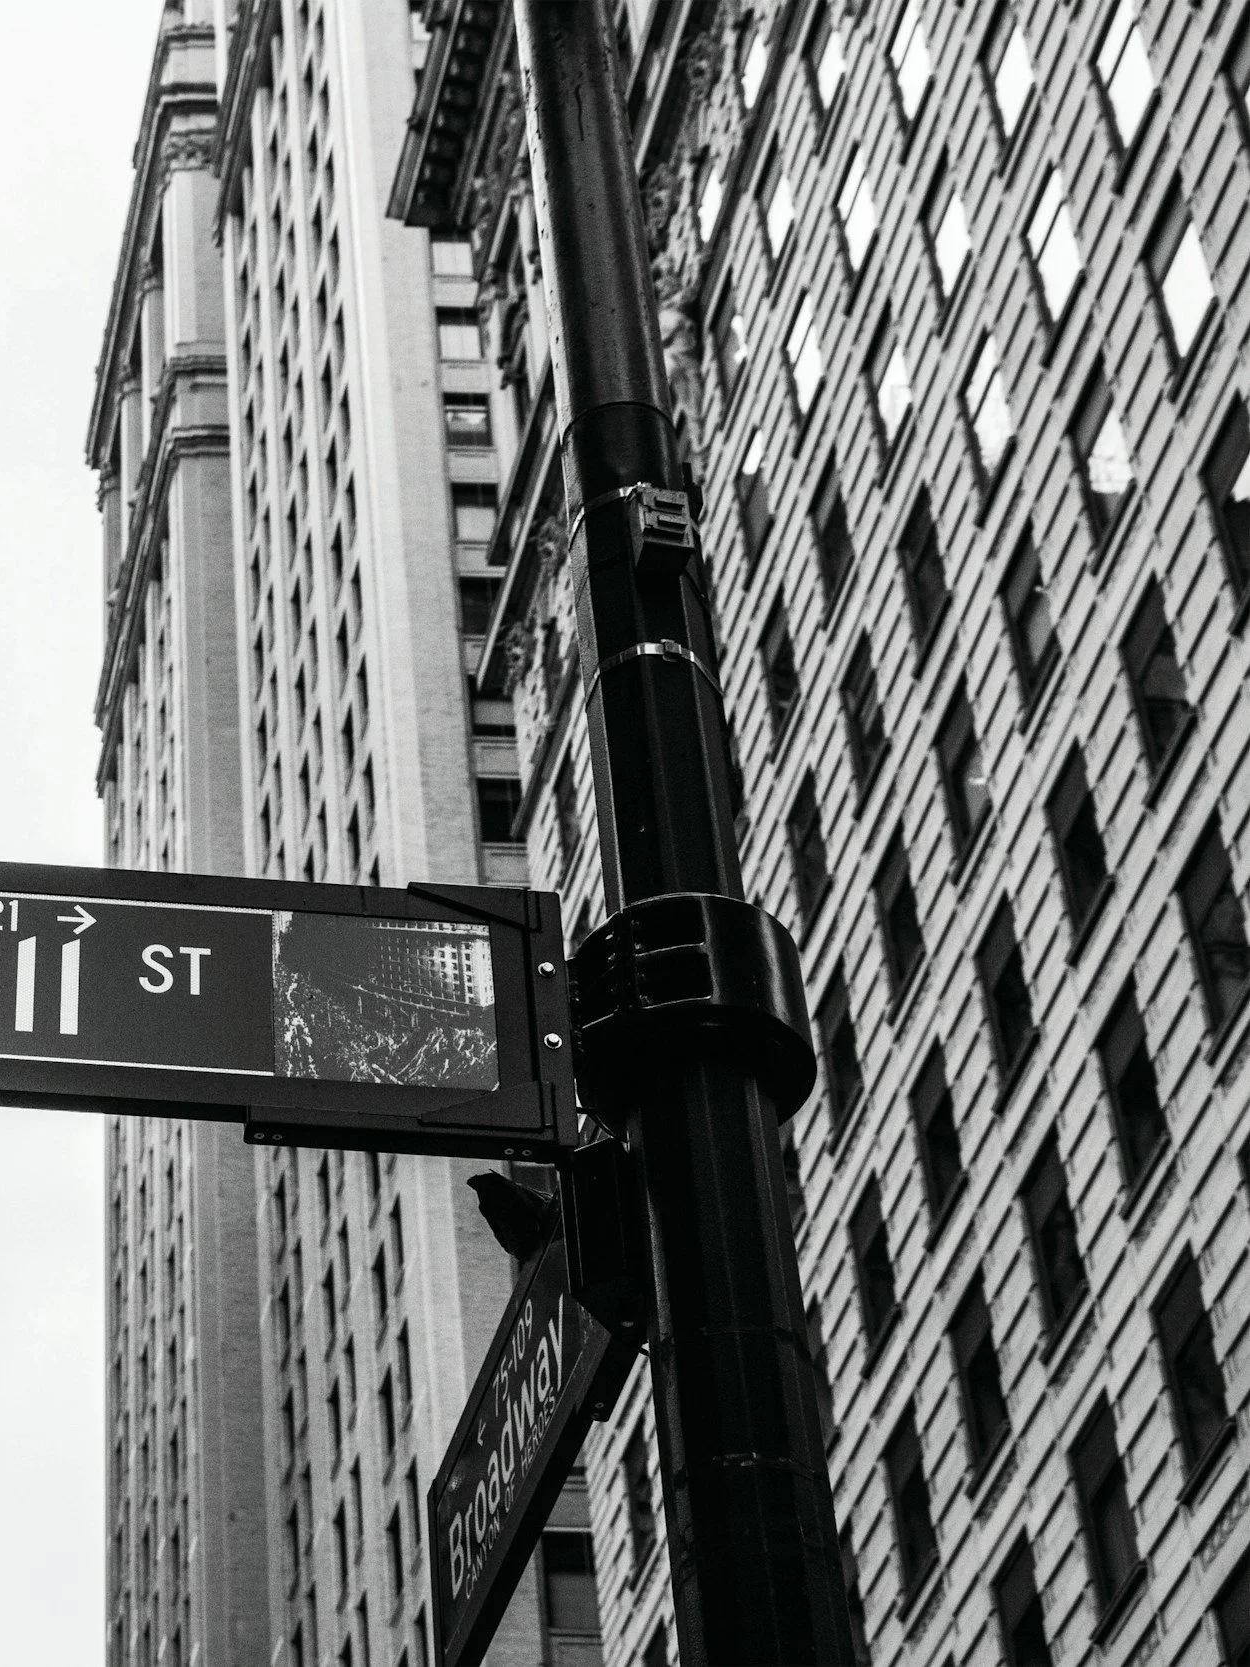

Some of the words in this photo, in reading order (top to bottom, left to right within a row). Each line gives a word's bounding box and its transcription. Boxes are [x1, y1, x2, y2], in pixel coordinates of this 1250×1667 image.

[138, 944, 212, 996] ST
[492, 1298, 533, 1418] 75-109
[449, 1292, 564, 1600] Broadway
[465, 1508, 500, 1600] CANYON
[504, 1471, 516, 1513] OF
[521, 1386, 556, 1477] HEROES
